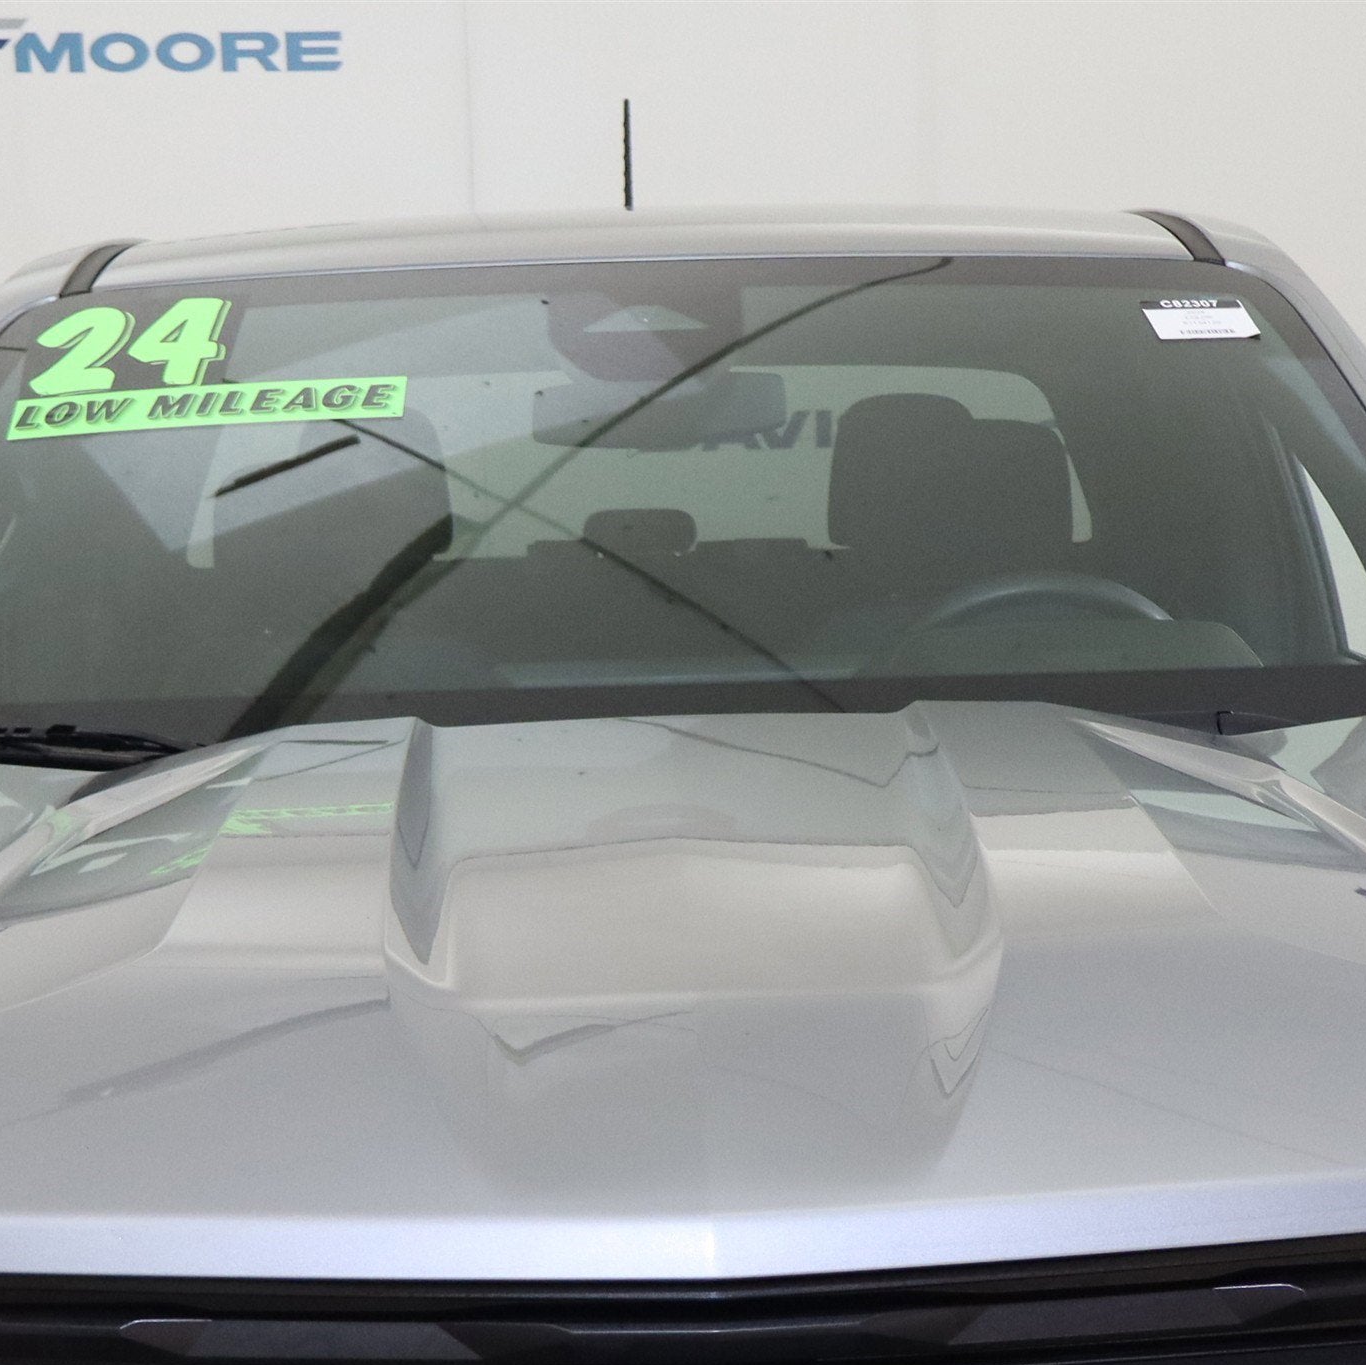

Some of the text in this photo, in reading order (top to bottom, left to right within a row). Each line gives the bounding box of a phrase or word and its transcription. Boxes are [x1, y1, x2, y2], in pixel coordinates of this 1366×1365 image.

[14, 31, 343, 73] MOORE
[28, 297, 233, 397] 24
[14, 383, 398, 432] LOW MILEAGE
